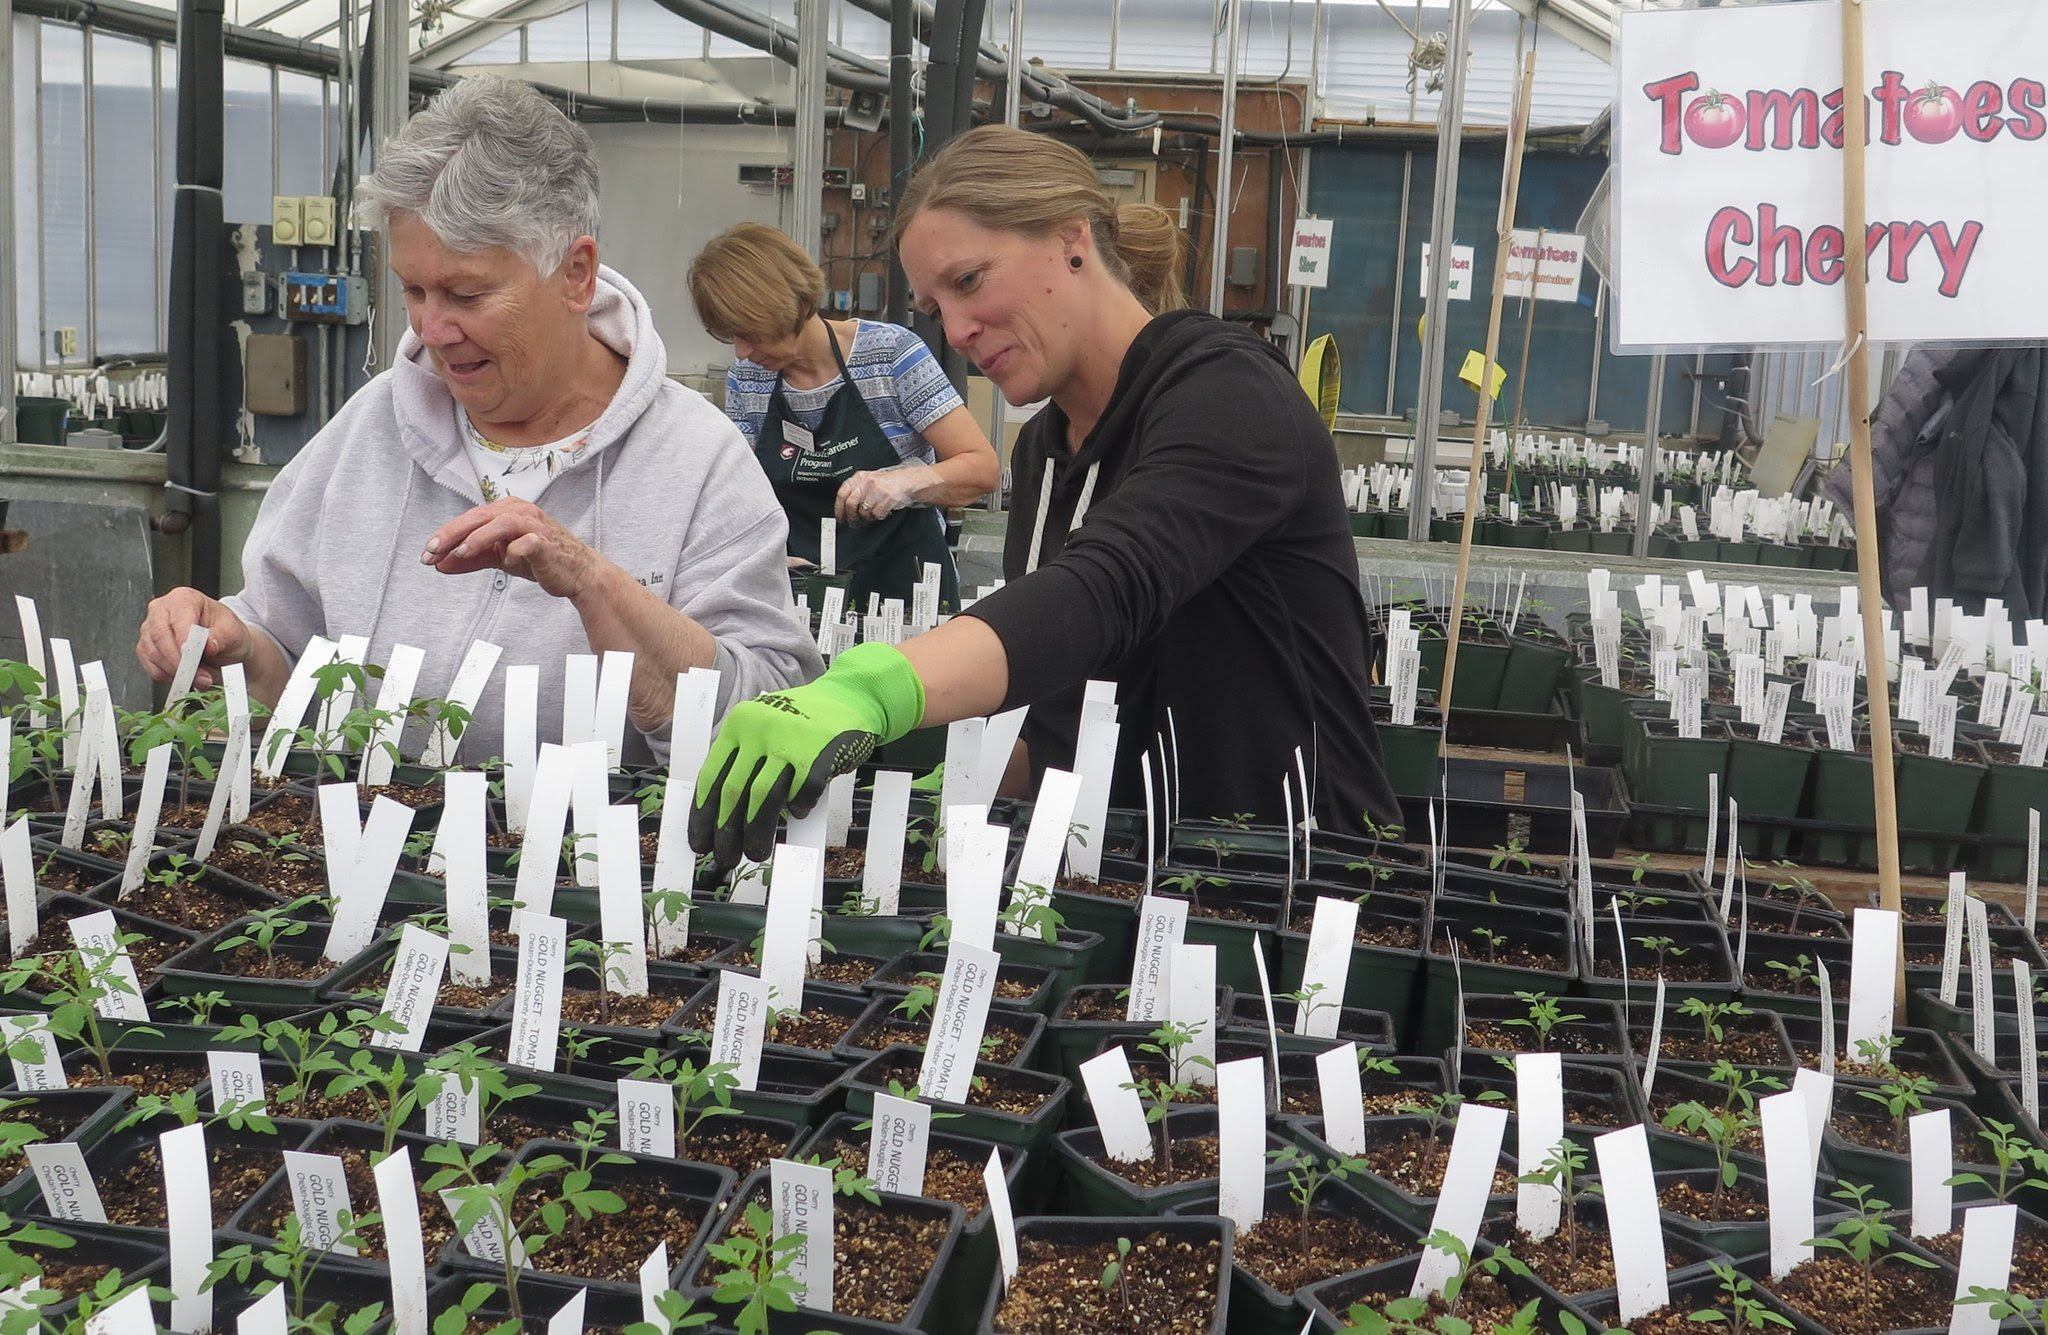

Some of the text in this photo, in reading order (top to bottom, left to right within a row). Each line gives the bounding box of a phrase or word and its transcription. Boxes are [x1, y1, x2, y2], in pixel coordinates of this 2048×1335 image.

[1643, 70, 2047, 156] Tomatoes
[1704, 203, 1983, 298] Cherry
[1154, 915, 1167, 943] GOLD
[537, 935, 550, 967] GOLD
[1148, 945, 1162, 987] NUGGET
[412, 953, 430, 983] GOLD
[962, 963, 978, 993] GOLD
[532, 970, 547, 1017] NUGGET
[730, 992, 750, 1069] GOLD NUGGE
[951, 995, 971, 1043] NUGGET
[525, 1028, 541, 1069] TOMAT
[232, 1070, 246, 1103] GOLD
[934, 1053, 957, 1100] TOMATO
[446, 1092, 458, 1124] GOLD
[639, 1102, 652, 1134] GOLD
[892, 1117, 906, 1148] GOLD
[53, 1164, 74, 1197] GOLD
[309, 1174, 326, 1206] GOLD
[794, 1184, 808, 1217] GOLD
